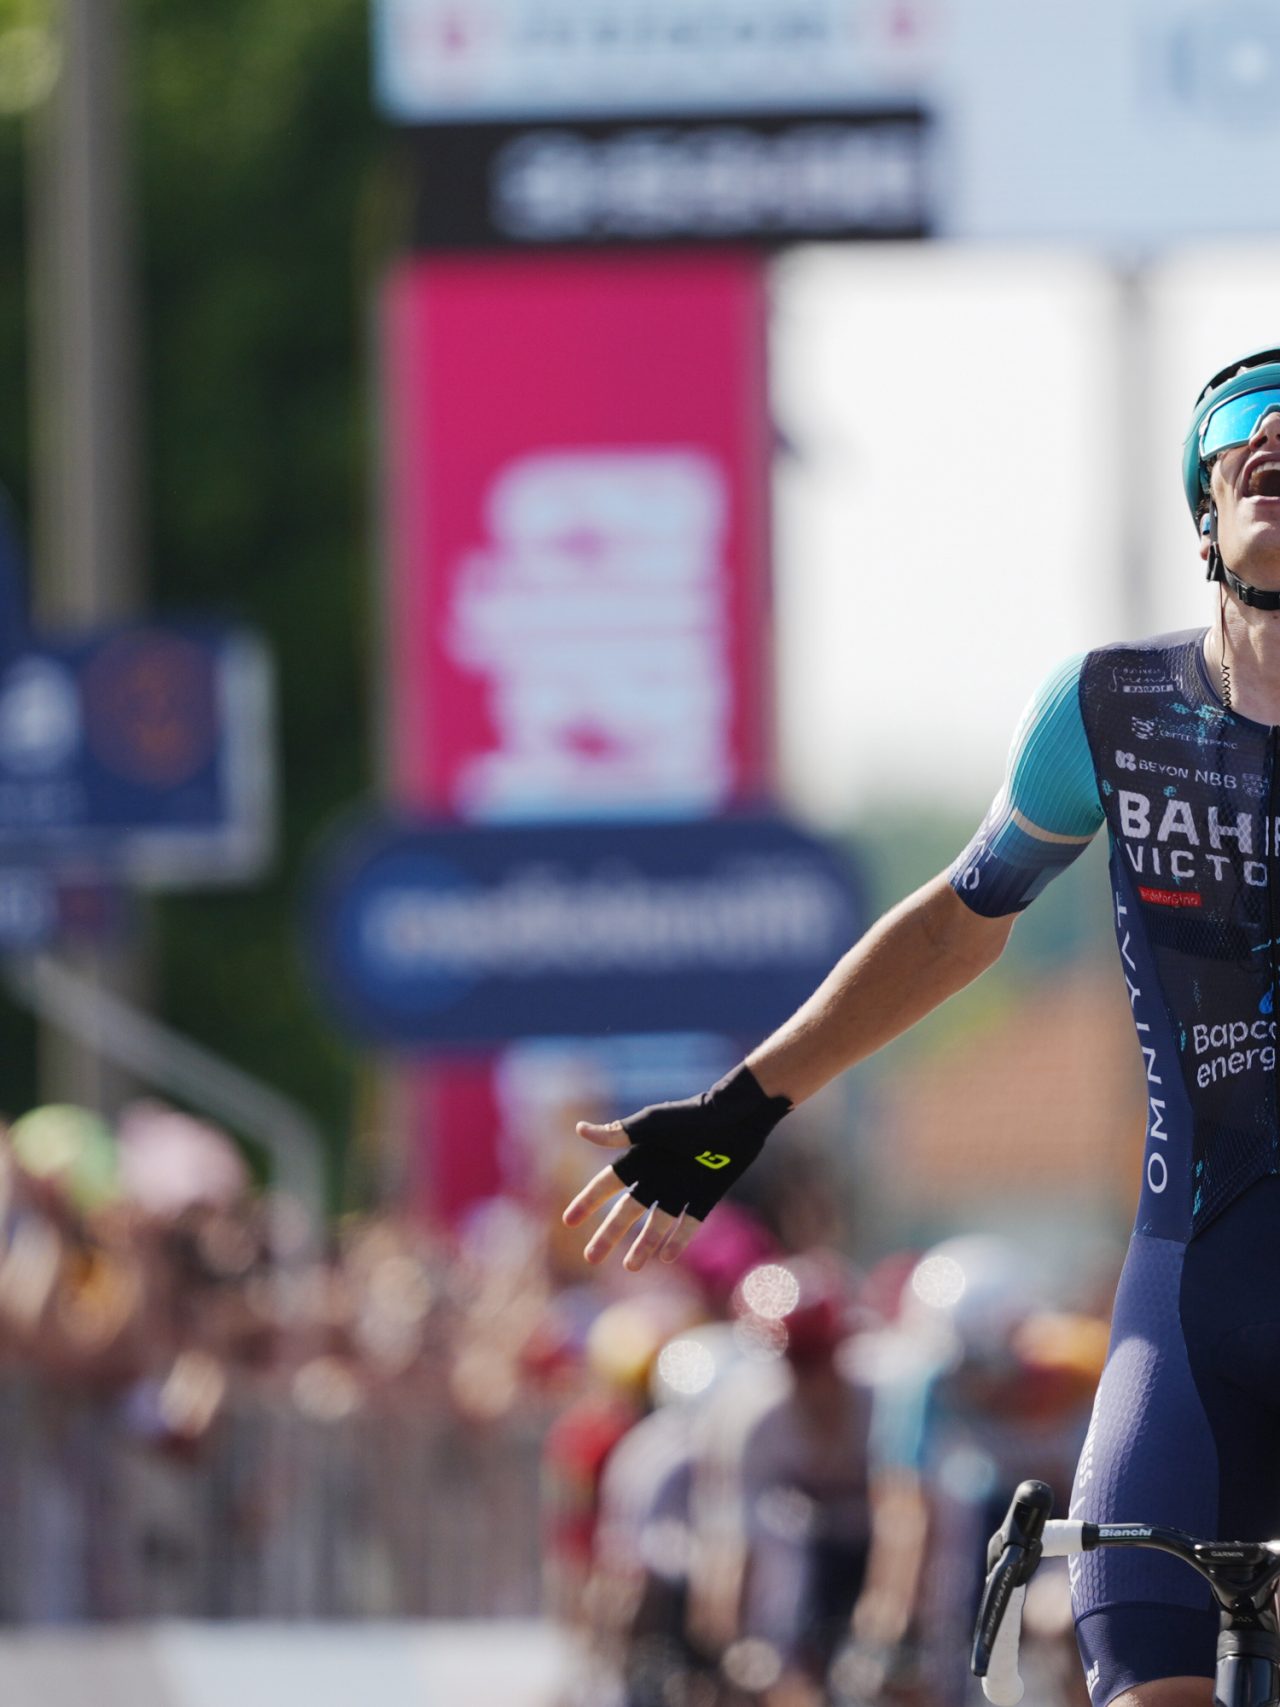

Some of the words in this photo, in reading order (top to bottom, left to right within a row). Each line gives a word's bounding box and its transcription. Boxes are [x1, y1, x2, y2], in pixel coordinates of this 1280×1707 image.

[1138, 760, 1190, 779] BEYON
[1194, 769, 1238, 789] NBB
[1115, 891, 1169, 1194] OMNIYAT
[1098, 1528, 1153, 1538] Bianchi
[1211, 1550, 1245, 1558] GARMIN
